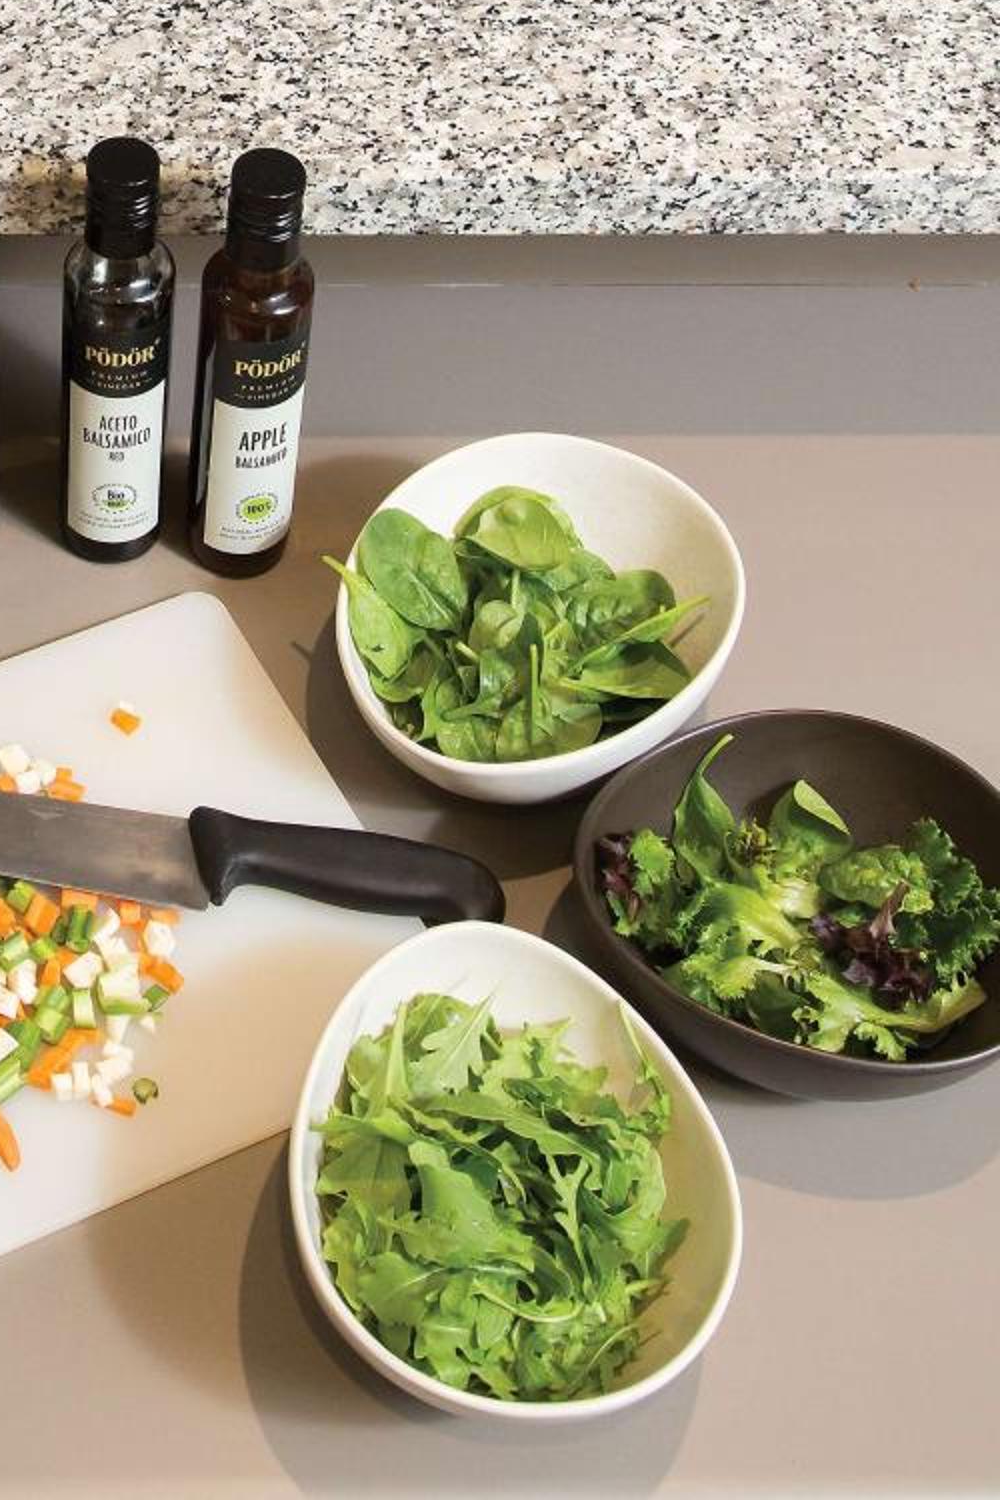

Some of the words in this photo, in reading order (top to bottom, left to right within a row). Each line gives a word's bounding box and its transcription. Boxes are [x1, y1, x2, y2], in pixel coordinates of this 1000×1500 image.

[85, 345, 155, 367] PÖDÖR
[234, 349, 301, 378] PÖDÖR
[99, 414, 137, 432] ACETO
[83, 427, 151, 449] BALSAMICO
[238, 421, 288, 451] APPLE
